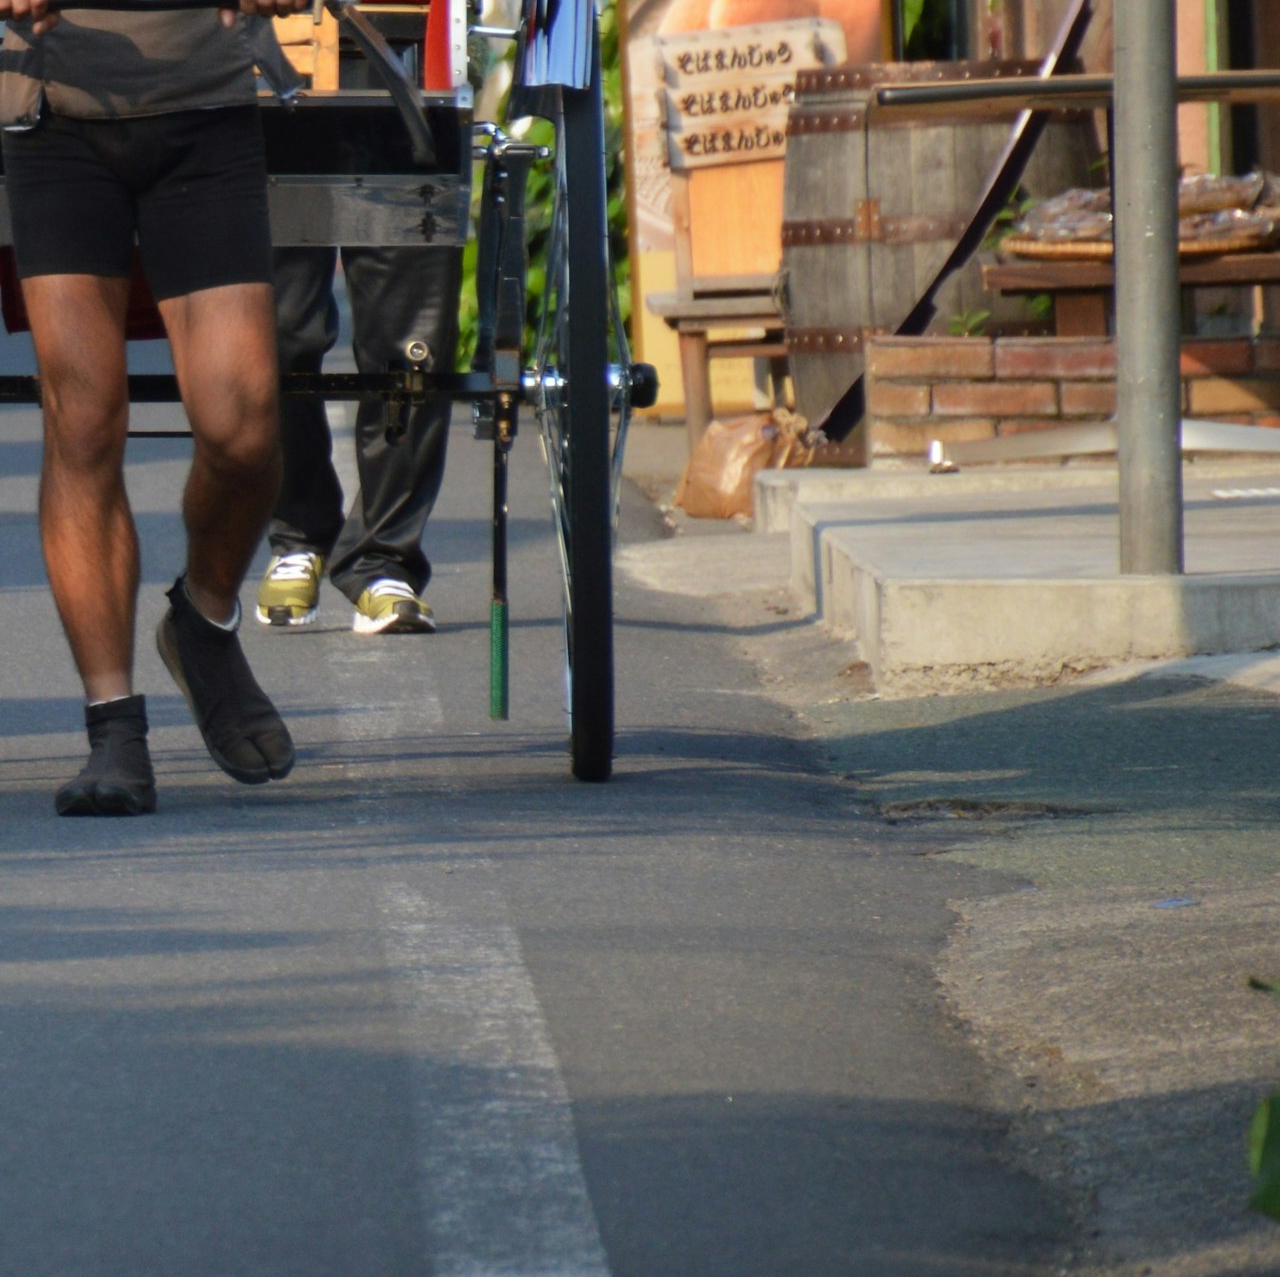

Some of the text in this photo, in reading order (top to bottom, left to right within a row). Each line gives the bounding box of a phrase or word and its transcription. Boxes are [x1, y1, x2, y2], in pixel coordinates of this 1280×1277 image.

[677, 41, 792, 75] そばまんじゅう
[684, 124, 785, 156] そばまんじゅ
